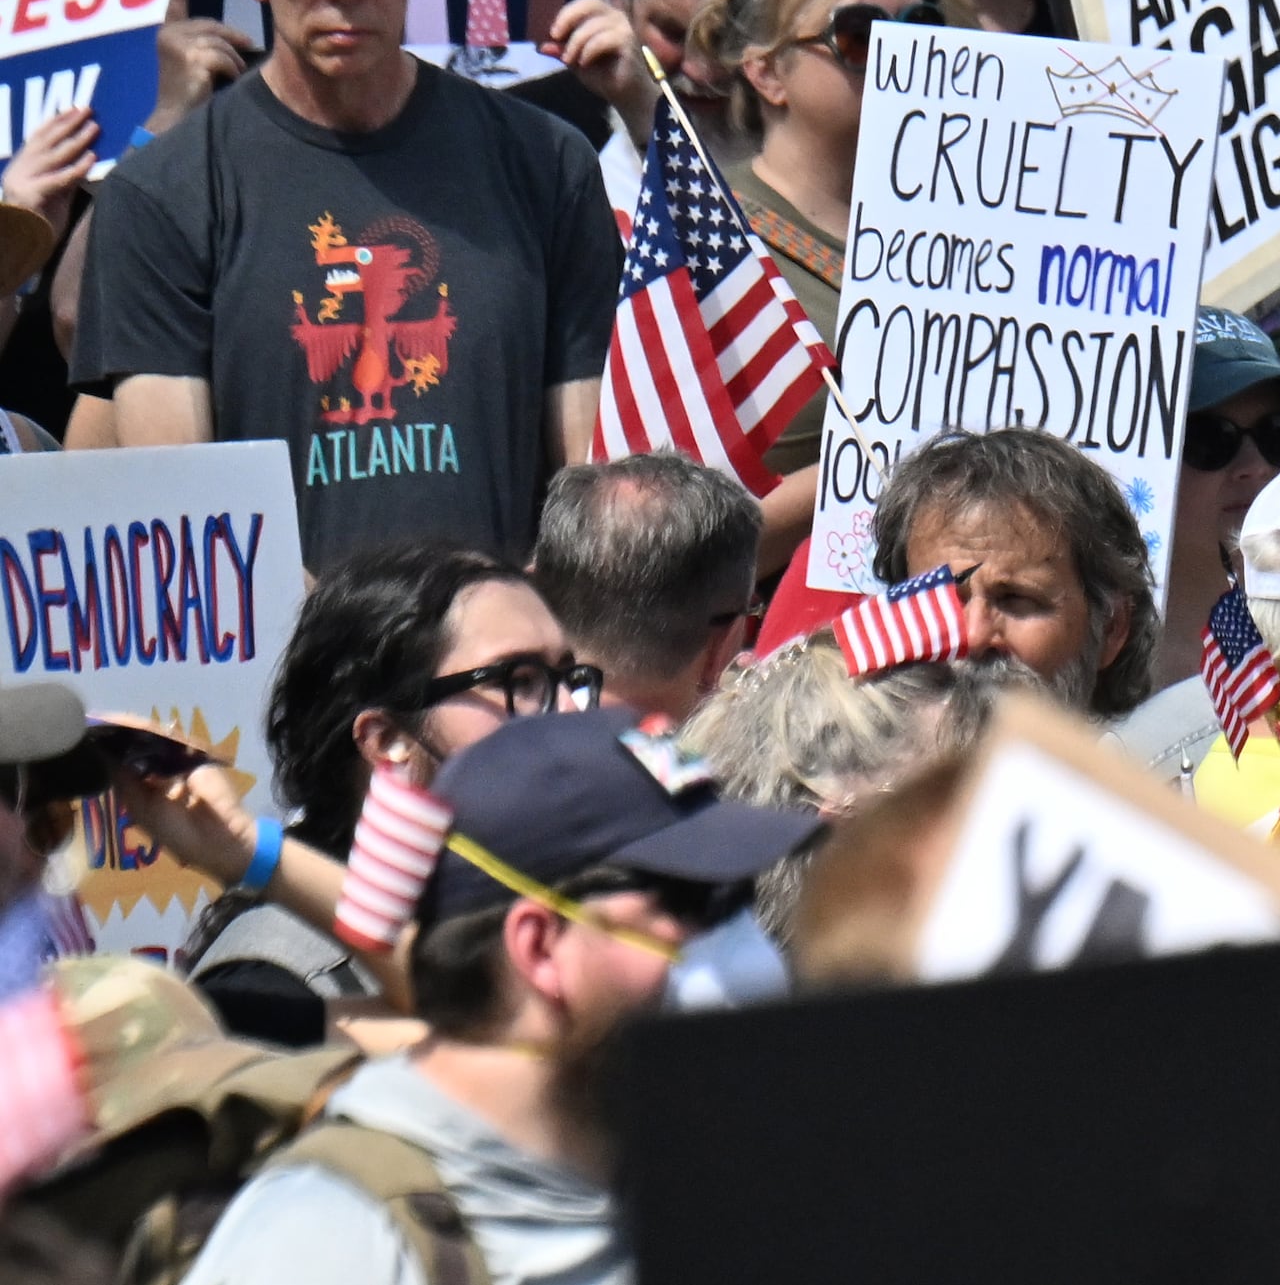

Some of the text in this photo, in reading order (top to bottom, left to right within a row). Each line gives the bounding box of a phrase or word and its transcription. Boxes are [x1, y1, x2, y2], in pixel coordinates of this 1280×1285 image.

[889, 108, 1205, 230] CRUELTY
[850, 201, 1177, 319] becomes normal
[833, 296, 1187, 461] COMPASSION
[306, 421, 460, 488] ATLANTA
[0, 512, 263, 675] DEMOCRACY
